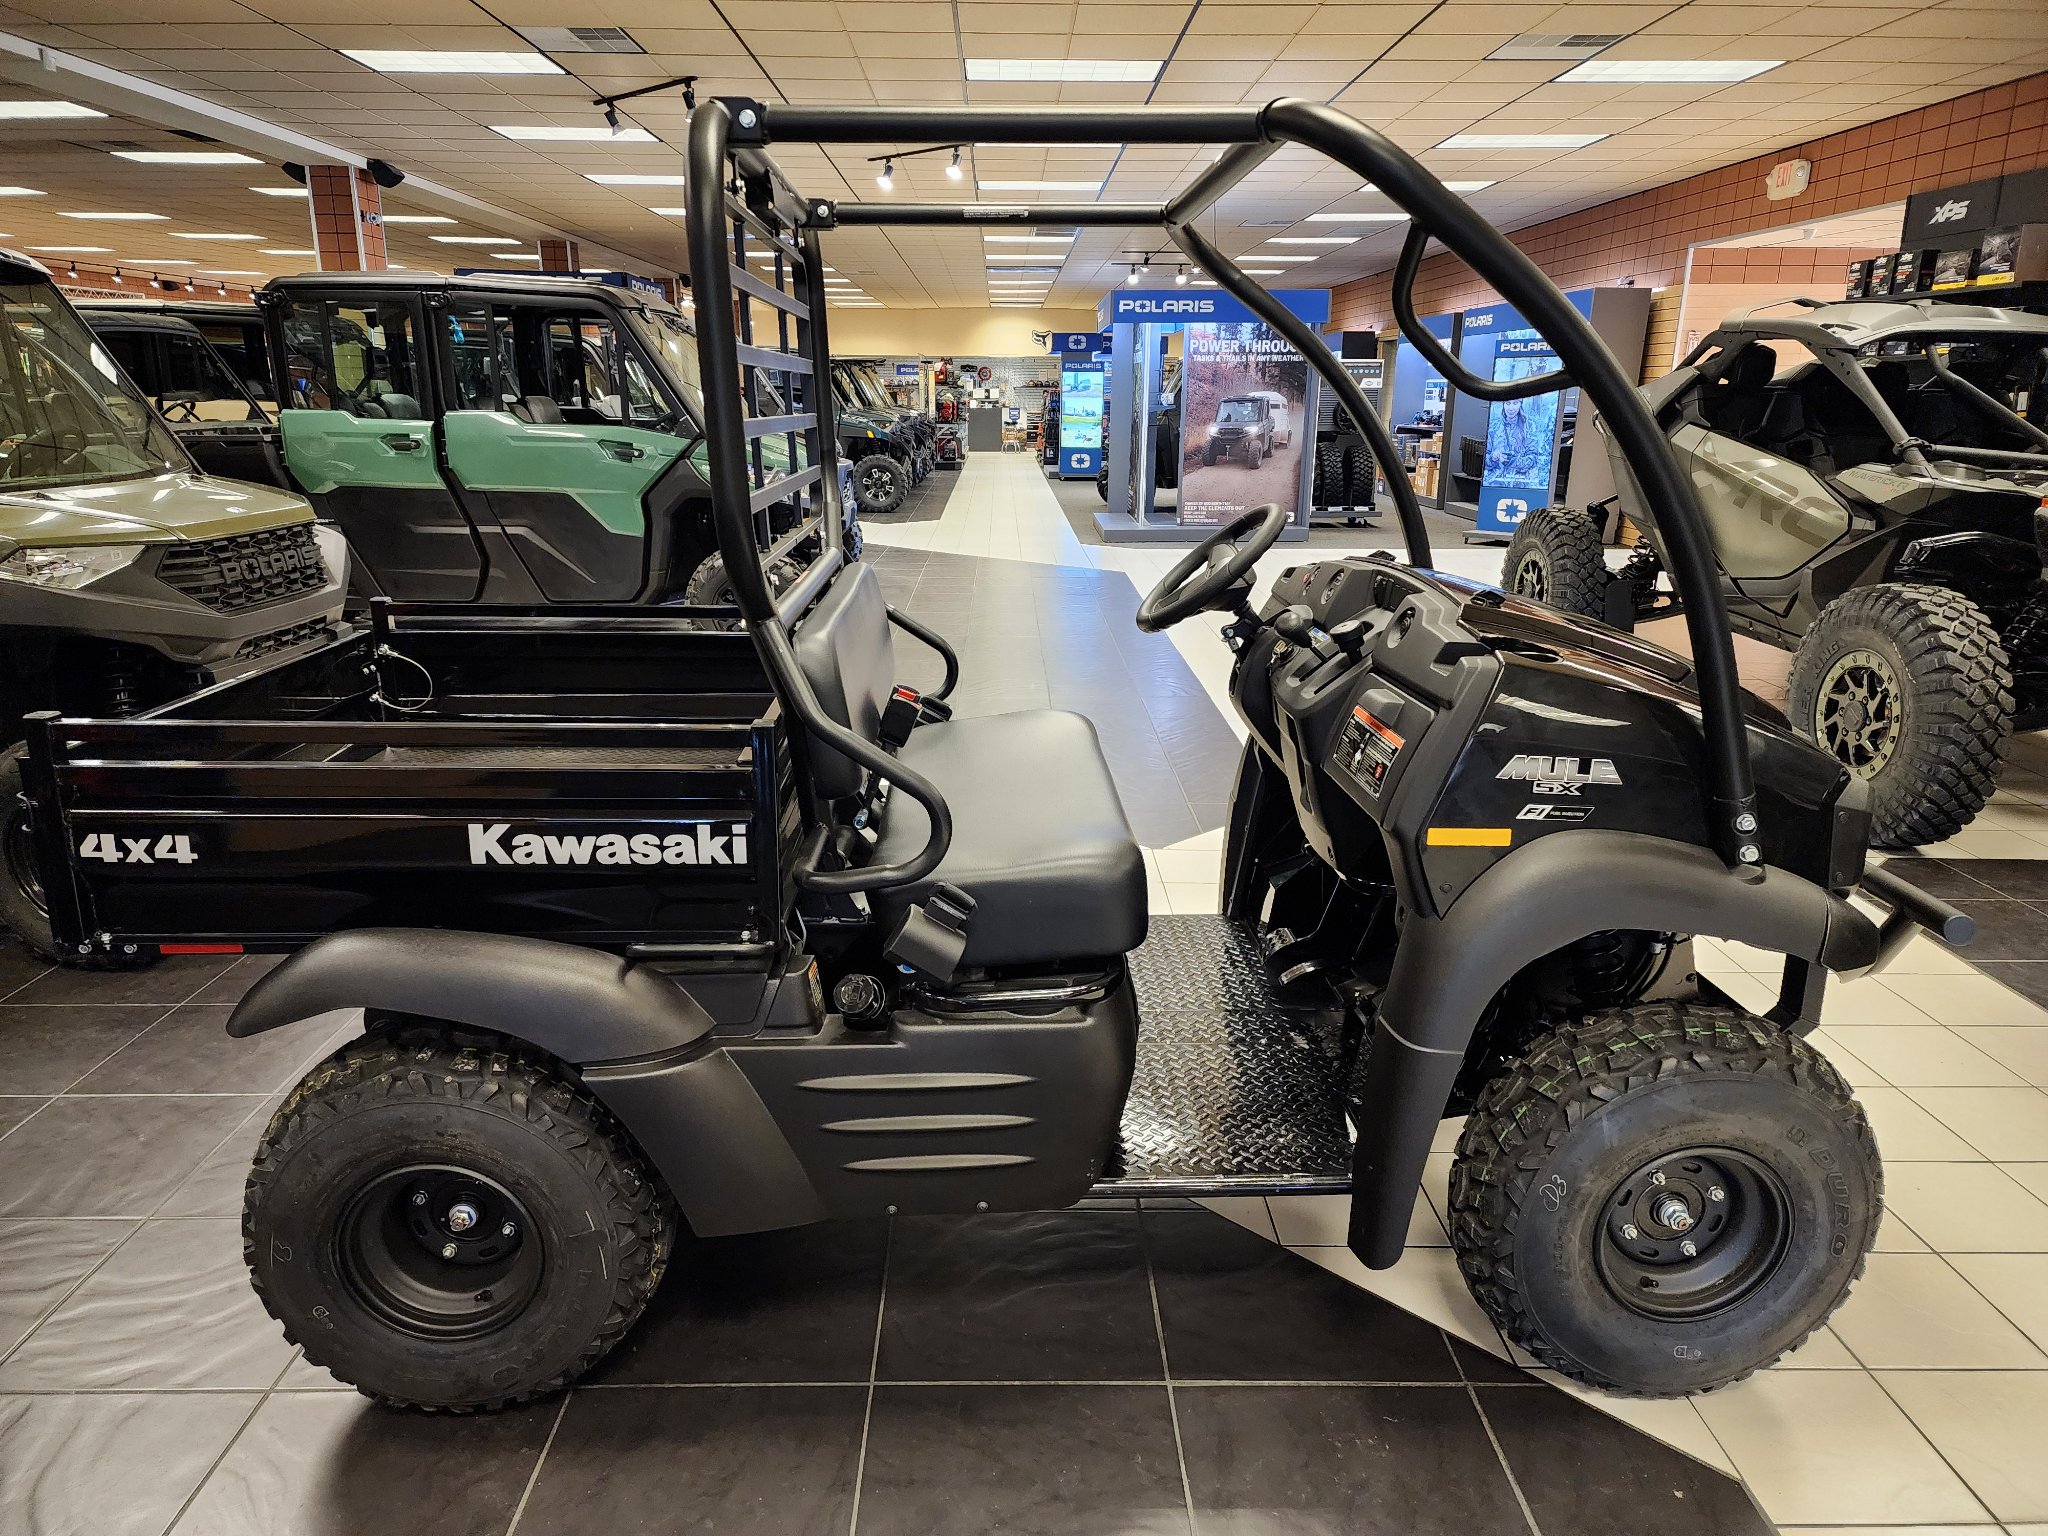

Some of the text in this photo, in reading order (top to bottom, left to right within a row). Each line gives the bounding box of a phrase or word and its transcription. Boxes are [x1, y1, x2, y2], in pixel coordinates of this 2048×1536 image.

[1776, 163, 1794, 188] EXIT
[1928, 199, 1972, 225] XPS
[1118, 300, 1215, 313] POLARIS
[1465, 314, 1494, 328] POLARIS
[1190, 340, 1240, 353] POWER
[1193, 354, 1215, 362] TASKS
[1223, 354, 1246, 362] TRAILS
[1247, 354, 1256, 362] IN
[1257, 354, 1271, 362] ANY
[1272, 354, 1304, 362] WEATHER
[220, 545, 322, 585] POLARIS
[1495, 754, 1623, 785] MULE
[1532, 781, 1583, 796] SX
[80, 833, 199, 863] 4x4
[467, 823, 748, 864] Kawasaki
[1808, 1146, 1851, 1257] DURO
